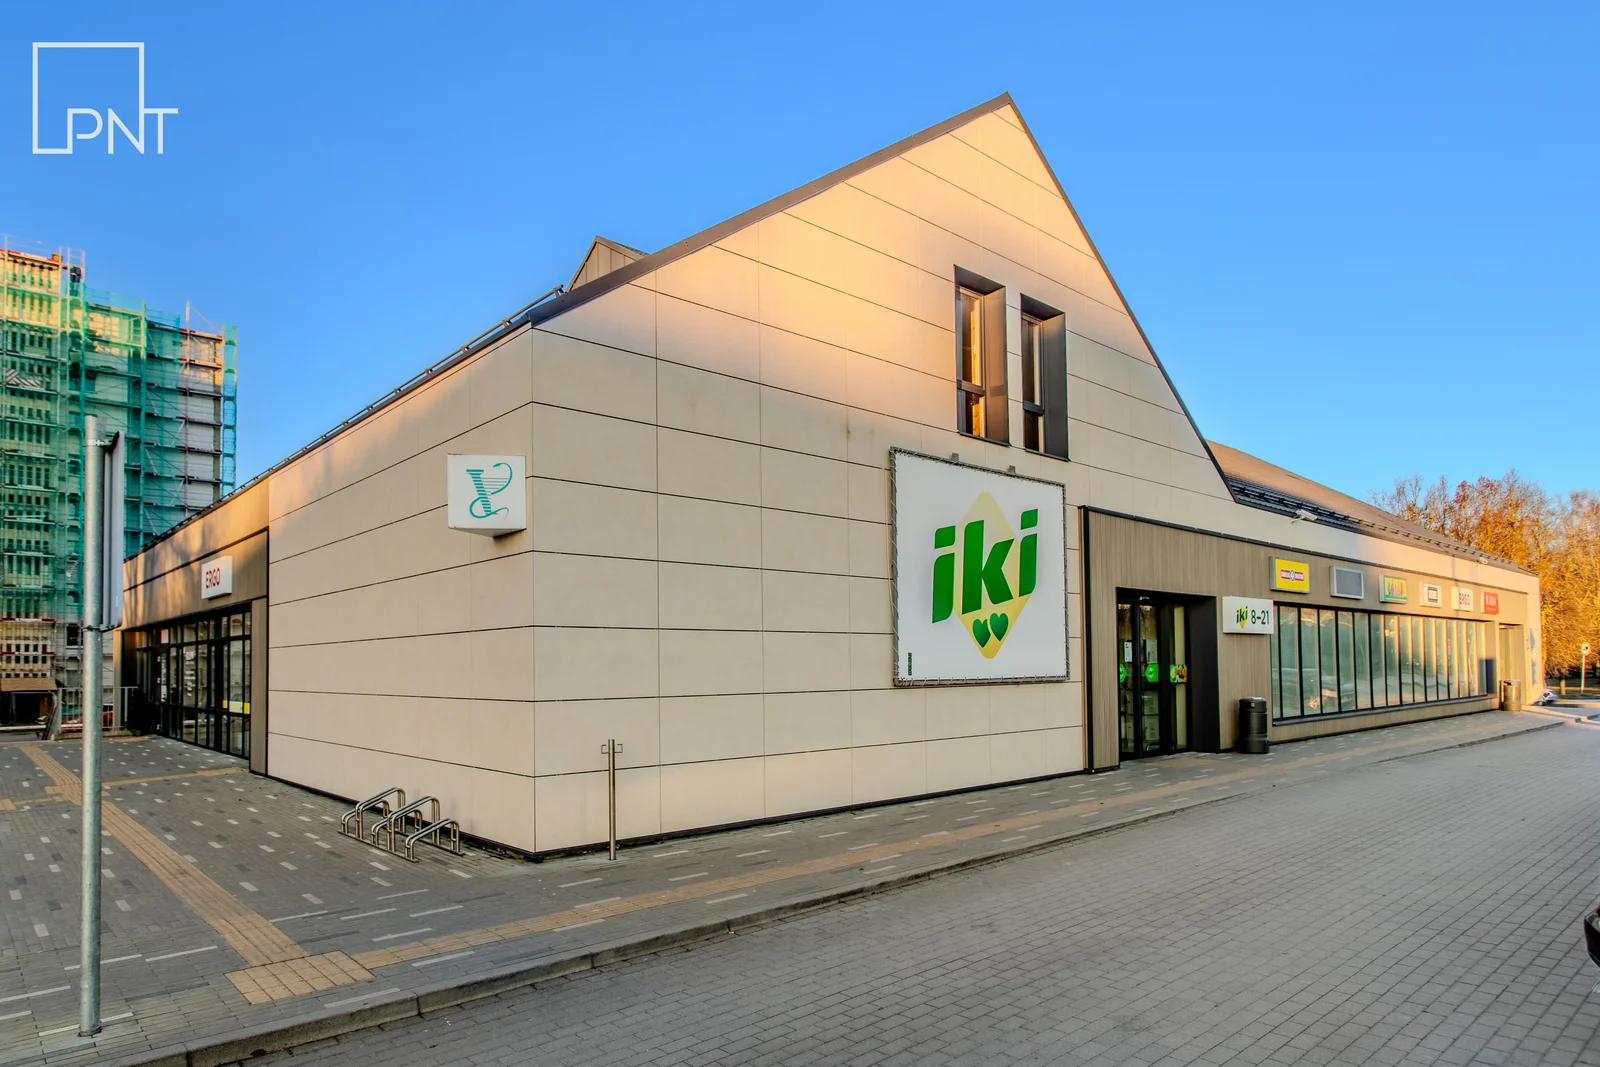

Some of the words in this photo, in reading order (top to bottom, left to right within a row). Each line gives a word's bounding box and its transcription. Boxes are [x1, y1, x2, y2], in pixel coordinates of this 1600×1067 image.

[932, 509, 1038, 624] iki
[206, 567, 220, 589] ERGO
[1459, 592, 1470, 606] ERGO
[1236, 605, 1248, 624] iki
